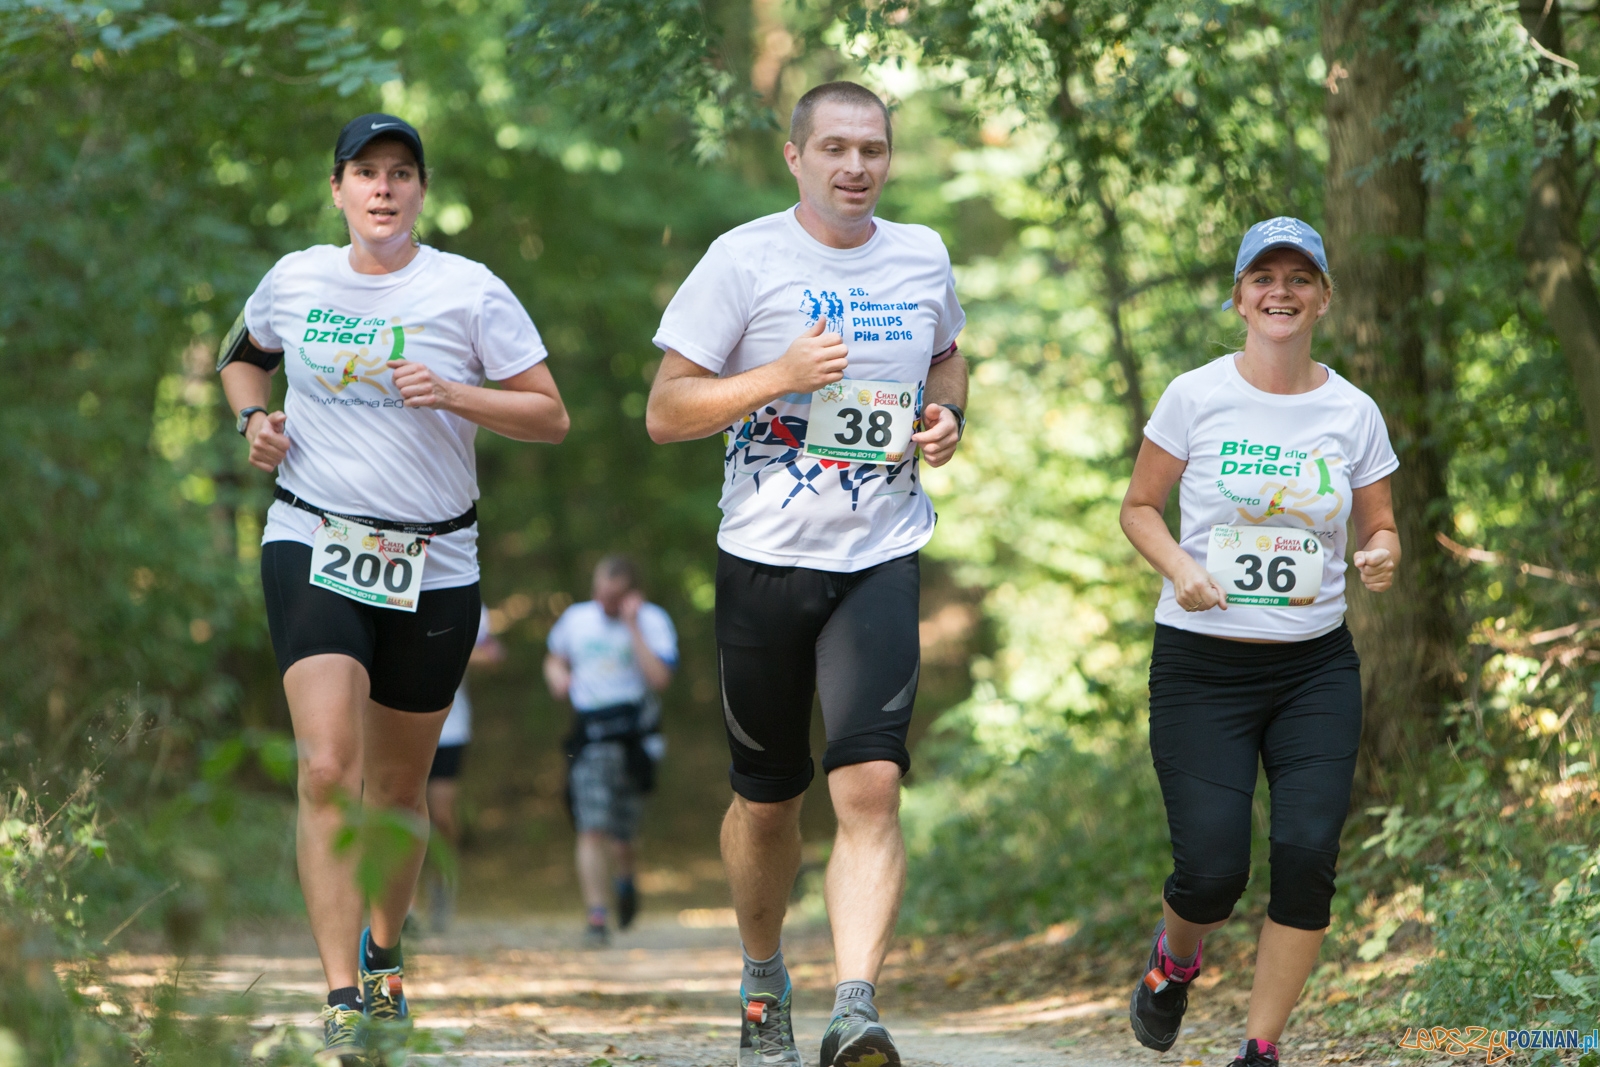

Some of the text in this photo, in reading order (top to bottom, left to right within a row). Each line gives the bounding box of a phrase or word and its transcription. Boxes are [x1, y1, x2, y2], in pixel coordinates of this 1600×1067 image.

[848, 288, 869, 297] 26.
[850, 301, 919, 312] Półmaraton
[306, 309, 386, 329] Bieg dla
[853, 316, 903, 327] PHILIPS
[303, 327, 378, 345] Dzieci
[854, 330, 913, 342] Piła 2016
[298, 346, 335, 374] Roberta
[834, 407, 893, 448] 38
[1220, 439, 1308, 461] Bieg dla
[1220, 459, 1302, 477] Dzieci
[1215, 480, 1260, 506] Roberta
[321, 543, 413, 594] 200
[1233, 554, 1297, 593] 36
